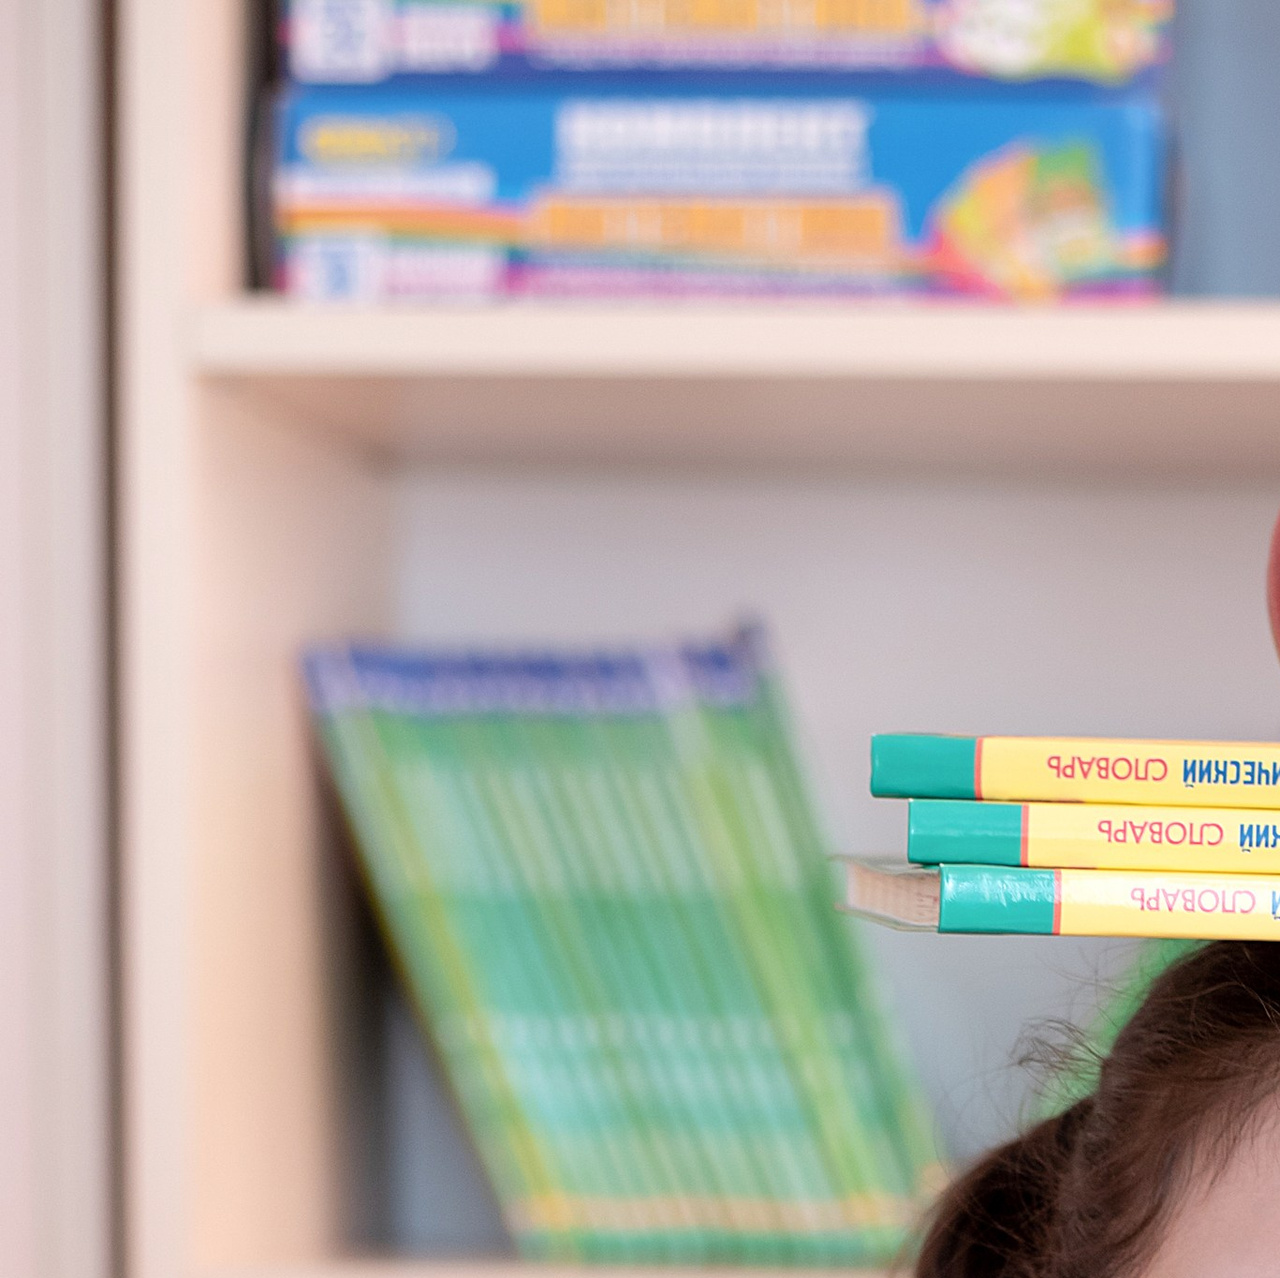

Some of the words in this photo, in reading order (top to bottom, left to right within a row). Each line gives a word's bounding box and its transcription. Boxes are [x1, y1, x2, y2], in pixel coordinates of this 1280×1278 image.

[1046, 756, 1168, 781] СЛОВАРЬ
[1097, 819, 1224, 846] СЛОВАРЬ
[1130, 888, 1257, 914] СЛОВАРЬ
